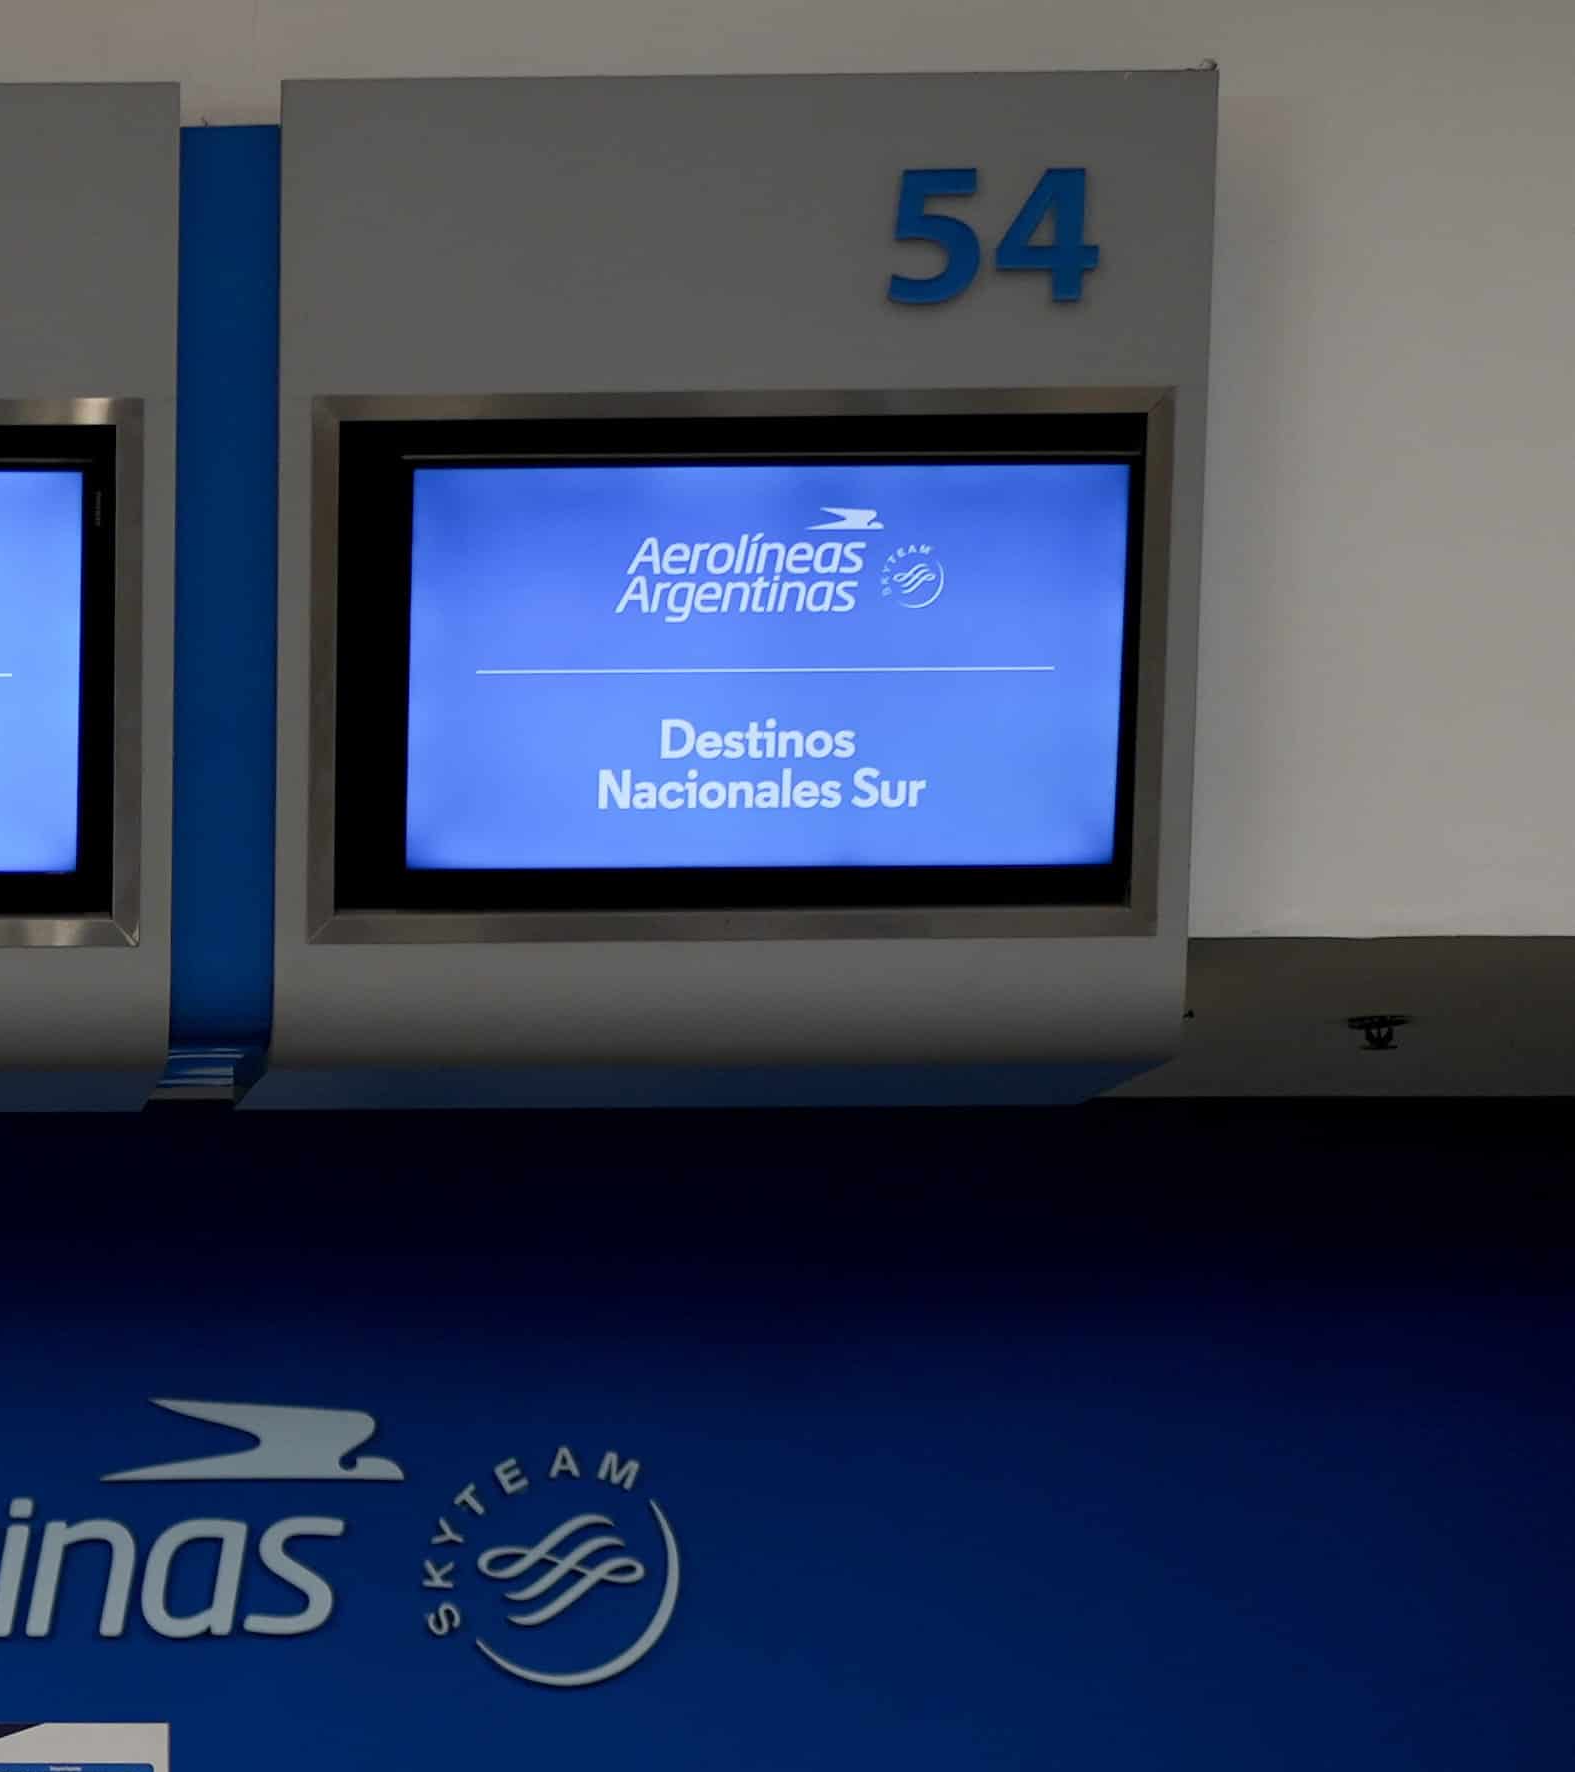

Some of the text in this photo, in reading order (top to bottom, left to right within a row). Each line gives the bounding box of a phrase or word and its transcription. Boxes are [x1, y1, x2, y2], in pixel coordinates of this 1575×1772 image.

[885, 166, 1101, 306] 54
[627, 532, 867, 575] Aerolíneas
[616, 576, 859, 623] Argentinas
[660, 718, 856, 759] Destinos
[598, 767, 926, 809] Nacionales Sur
[422, 1446, 640, 1637] SKYTEAM
